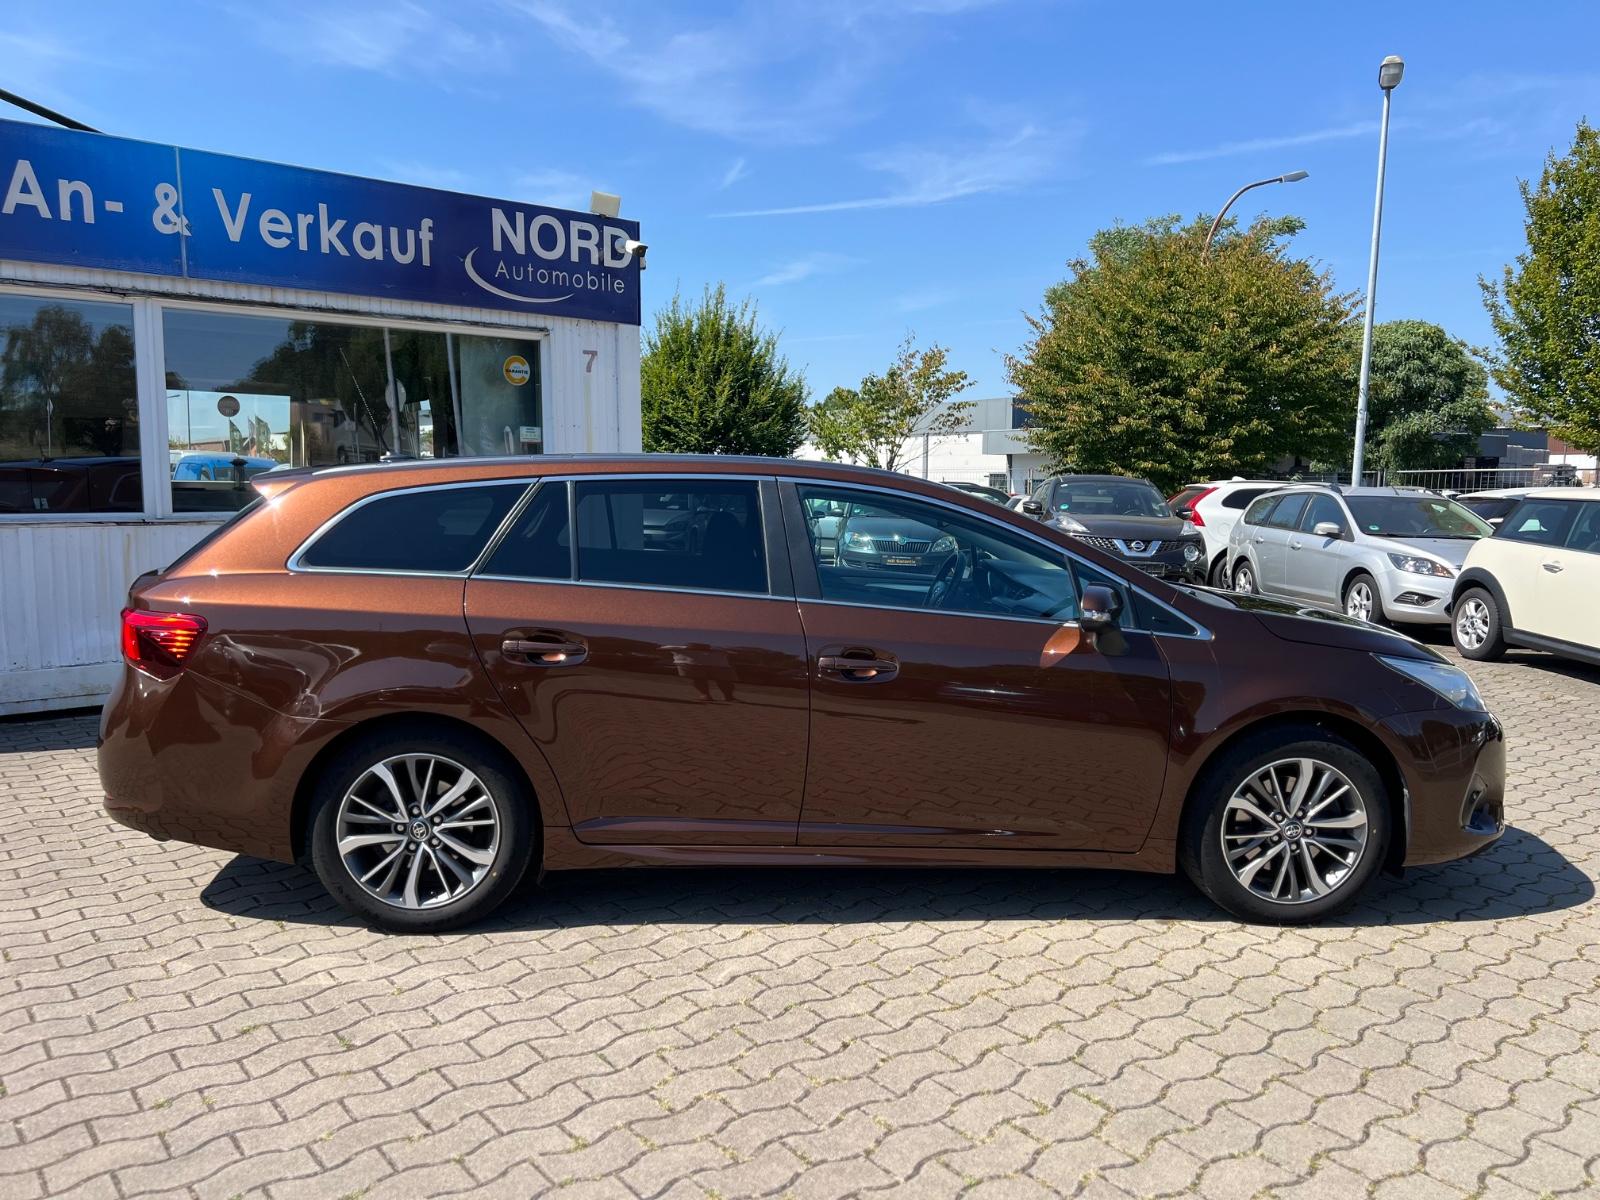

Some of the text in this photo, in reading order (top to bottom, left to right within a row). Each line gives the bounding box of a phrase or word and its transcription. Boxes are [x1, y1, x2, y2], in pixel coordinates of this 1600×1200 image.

[2, 159, 434, 267] An- & Verkauf
[491, 207, 633, 269] NORD
[495, 260, 625, 294] Automobile
[582, 350, 598, 374] 7
